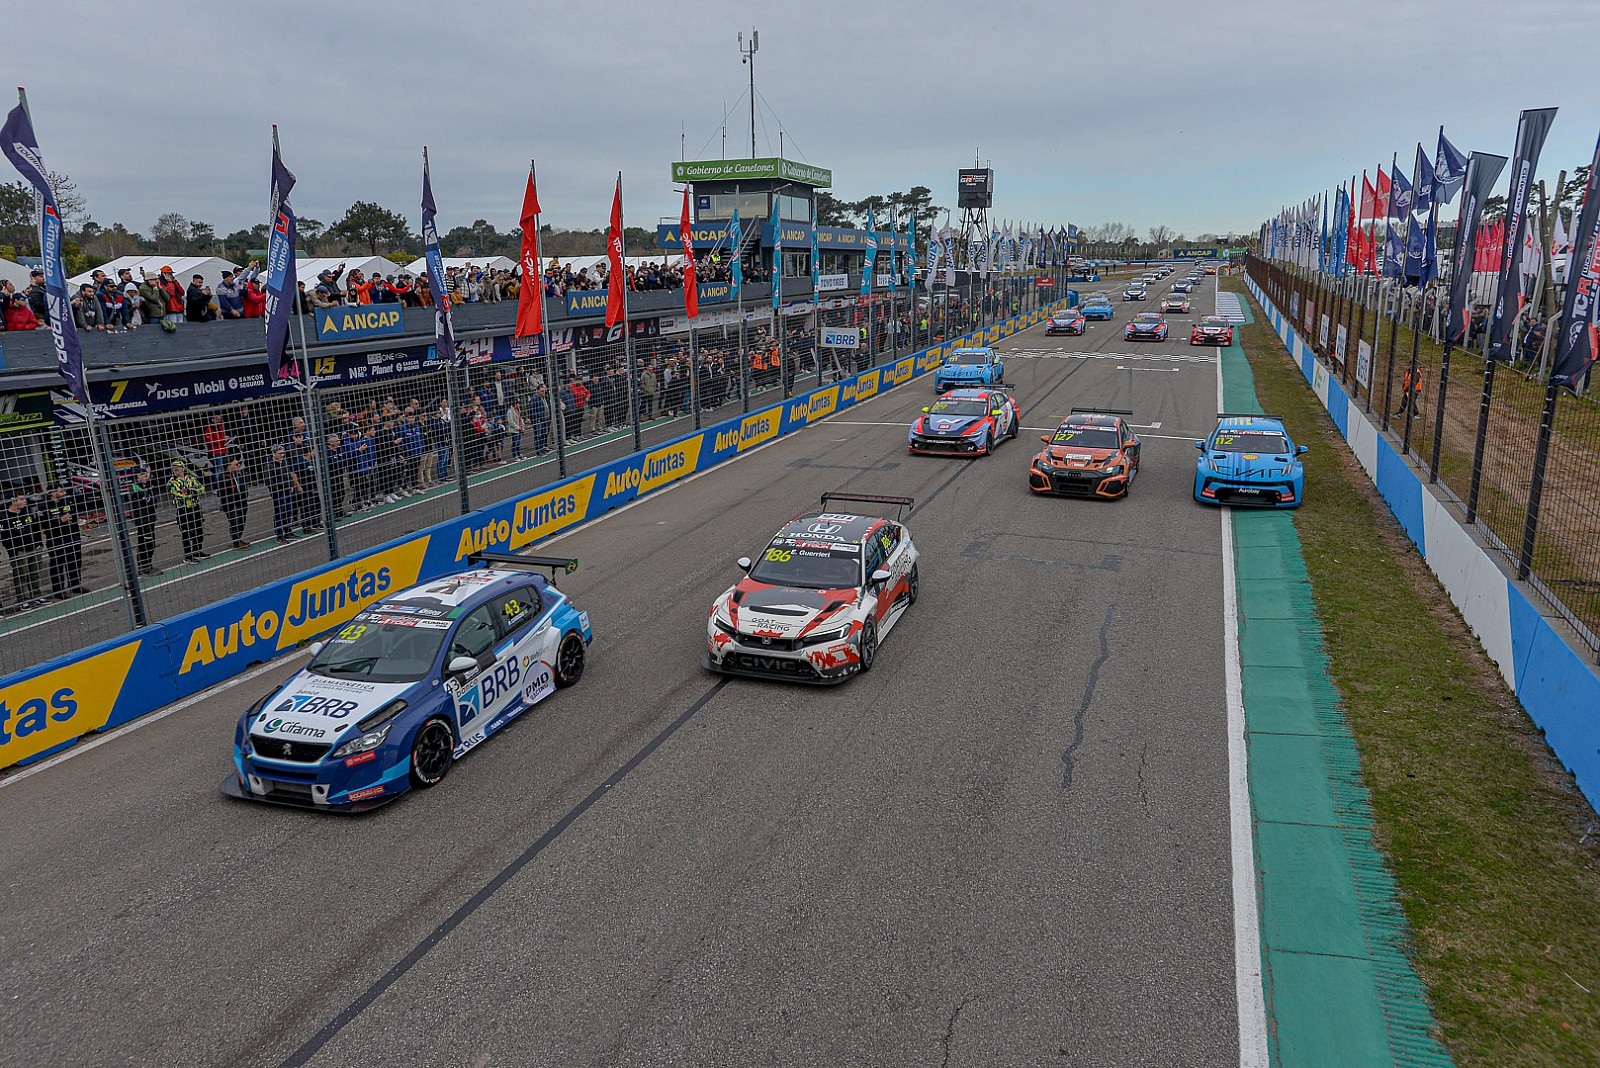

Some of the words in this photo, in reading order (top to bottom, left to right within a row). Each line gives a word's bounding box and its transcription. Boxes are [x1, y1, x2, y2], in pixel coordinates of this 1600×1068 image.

[686, 164, 722, 175] Gobierno
[723, 164, 733, 173] de
[735, 162, 774, 173] Canelones
[787, 163, 806, 179] Gobierno
[806, 170, 812, 178] de
[812, 169, 831, 182] Canelones
[681, 229, 727, 241] NCAP
[786, 229, 805, 241] ANCAP
[46, 219, 57, 277] America
[269, 234, 283, 279] America
[278, 240, 289, 272] South
[707, 286, 728, 297] ANCAP
[1572, 277, 1592, 318] TCR
[581, 296, 607, 309] ANCA
[342, 311, 400, 332] ANCAP
[50, 317, 68, 364] BRB
[835, 334, 856, 345] BRB
[278, 360, 301, 379] 44
[314, 357, 336, 375] 15
[371, 363, 393, 375] Planet
[896, 363, 909, 379] Juntas
[238, 374, 264, 383] SANCOR
[239, 379, 265, 389] SEGUROS
[110, 380, 129, 402] 7
[194, 380, 225, 396] Mobil
[842, 385, 857, 401] Auto
[857, 377, 874, 396] Juntas
[790, 403, 808, 423] Auto
[808, 393, 831, 415] Juntas
[714, 427, 739, 453] Auto
[741, 417, 770, 441] Juntas
[1053, 433, 1075, 441] 127
[1215, 437, 1234, 445] 112
[604, 467, 641, 499] Auto
[643, 449, 685, 482] Juntas
[455, 517, 510, 562] Auto
[516, 493, 576, 534] Juntas
[788, 532, 846, 542] HONDA
[764, 547, 791, 563] 186
[800, 550, 830, 558] Guerrieri
[505, 599, 520, 617] 43
[179, 609, 282, 675] Auto
[288, 570, 392, 627] Juntas
[757, 623, 790, 632] RACING
[339, 625, 367, 640] 43
[739, 655, 796, 671] CIVIC
[445, 678, 460, 694] 43
[456, 678, 478, 698] banco
[481, 654, 520, 710] BRB
[525, 671, 550, 698] PMO
[530, 682, 550, 701] RACING
[297, 696, 359, 719] BRB
[280, 720, 326, 738] Cifarma
